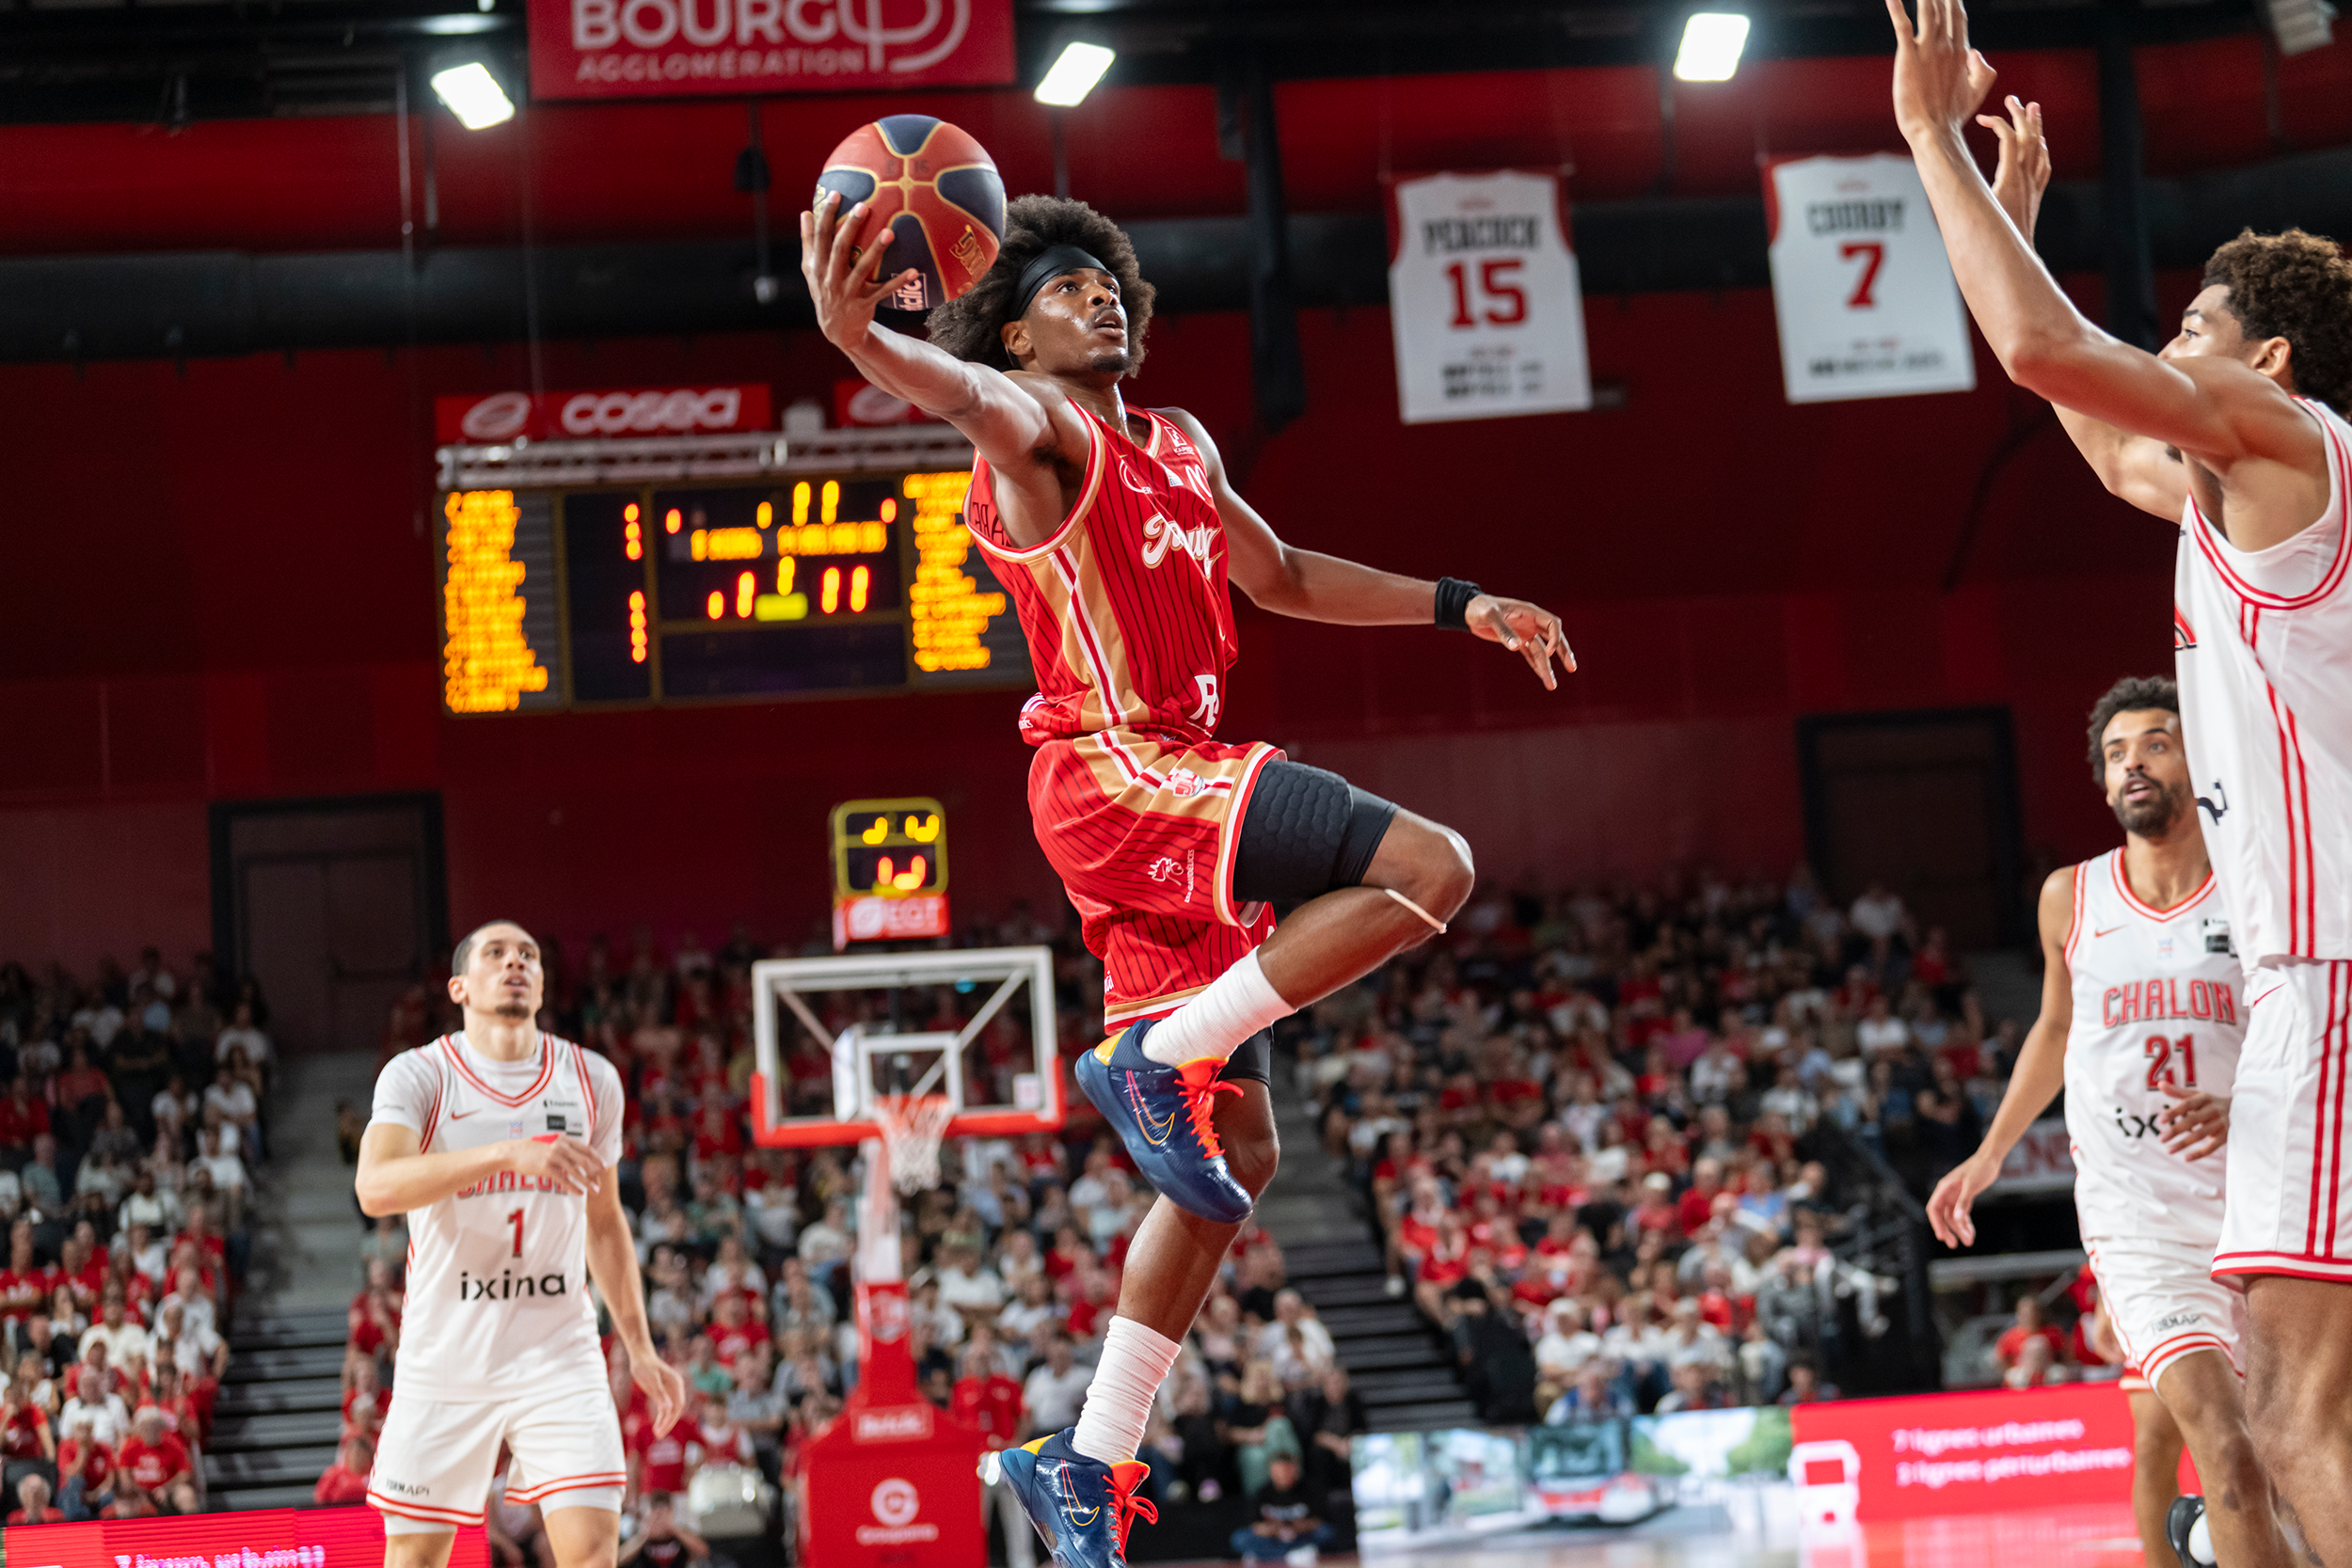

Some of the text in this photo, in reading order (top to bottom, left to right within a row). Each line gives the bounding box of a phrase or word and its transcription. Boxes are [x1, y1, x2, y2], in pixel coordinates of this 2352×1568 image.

[572, 0, 836, 50] BOURG
[1445, 259, 1528, 329] 15
[1839, 242, 1885, 310] 7
[2103, 977, 2237, 1028] CHALON
[2144, 1033, 2197, 1091] 21
[506, 1208, 525, 1258] 1
[460, 1270, 566, 1301] ixina
